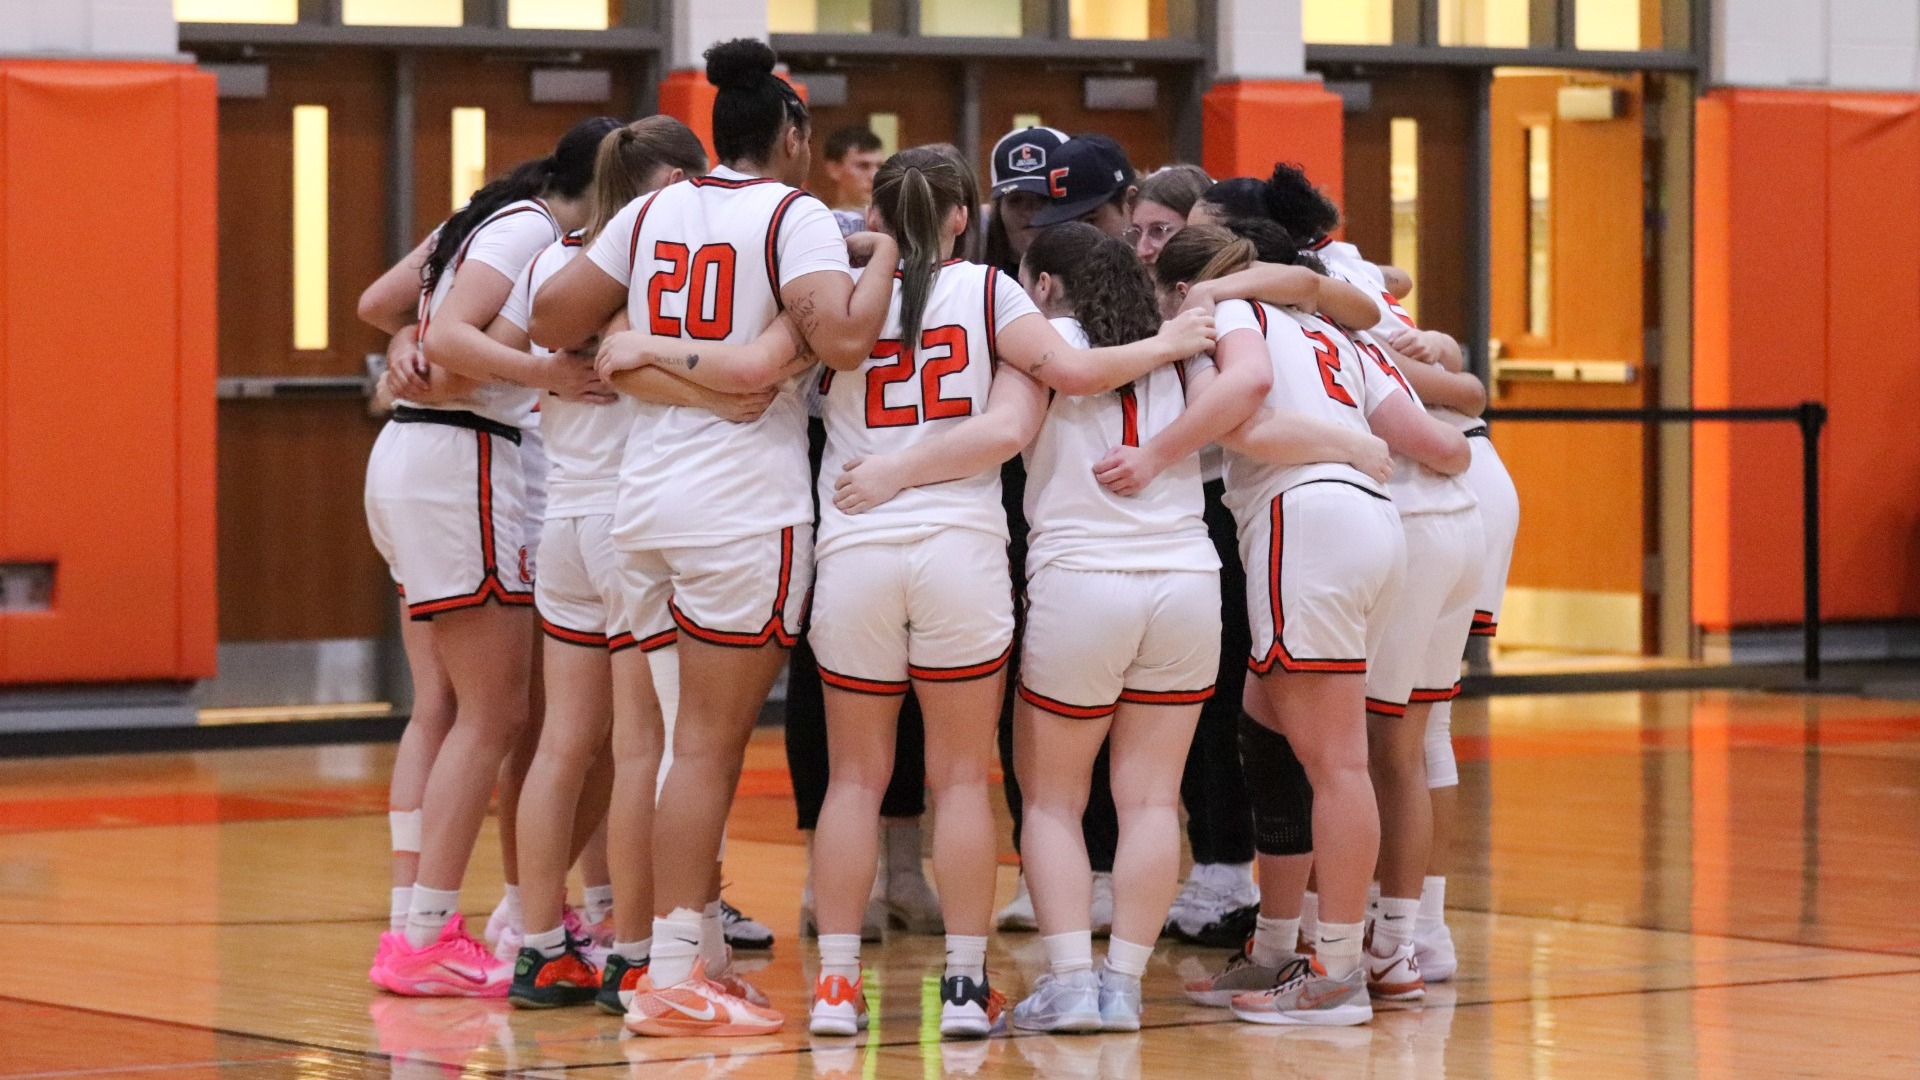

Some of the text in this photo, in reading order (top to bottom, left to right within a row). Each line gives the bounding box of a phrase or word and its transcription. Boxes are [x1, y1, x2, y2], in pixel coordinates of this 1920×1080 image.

[1050, 167, 1069, 198] C
[648, 240, 736, 341] 20
[865, 324, 972, 429] 22
[1300, 325, 1358, 409] 2
